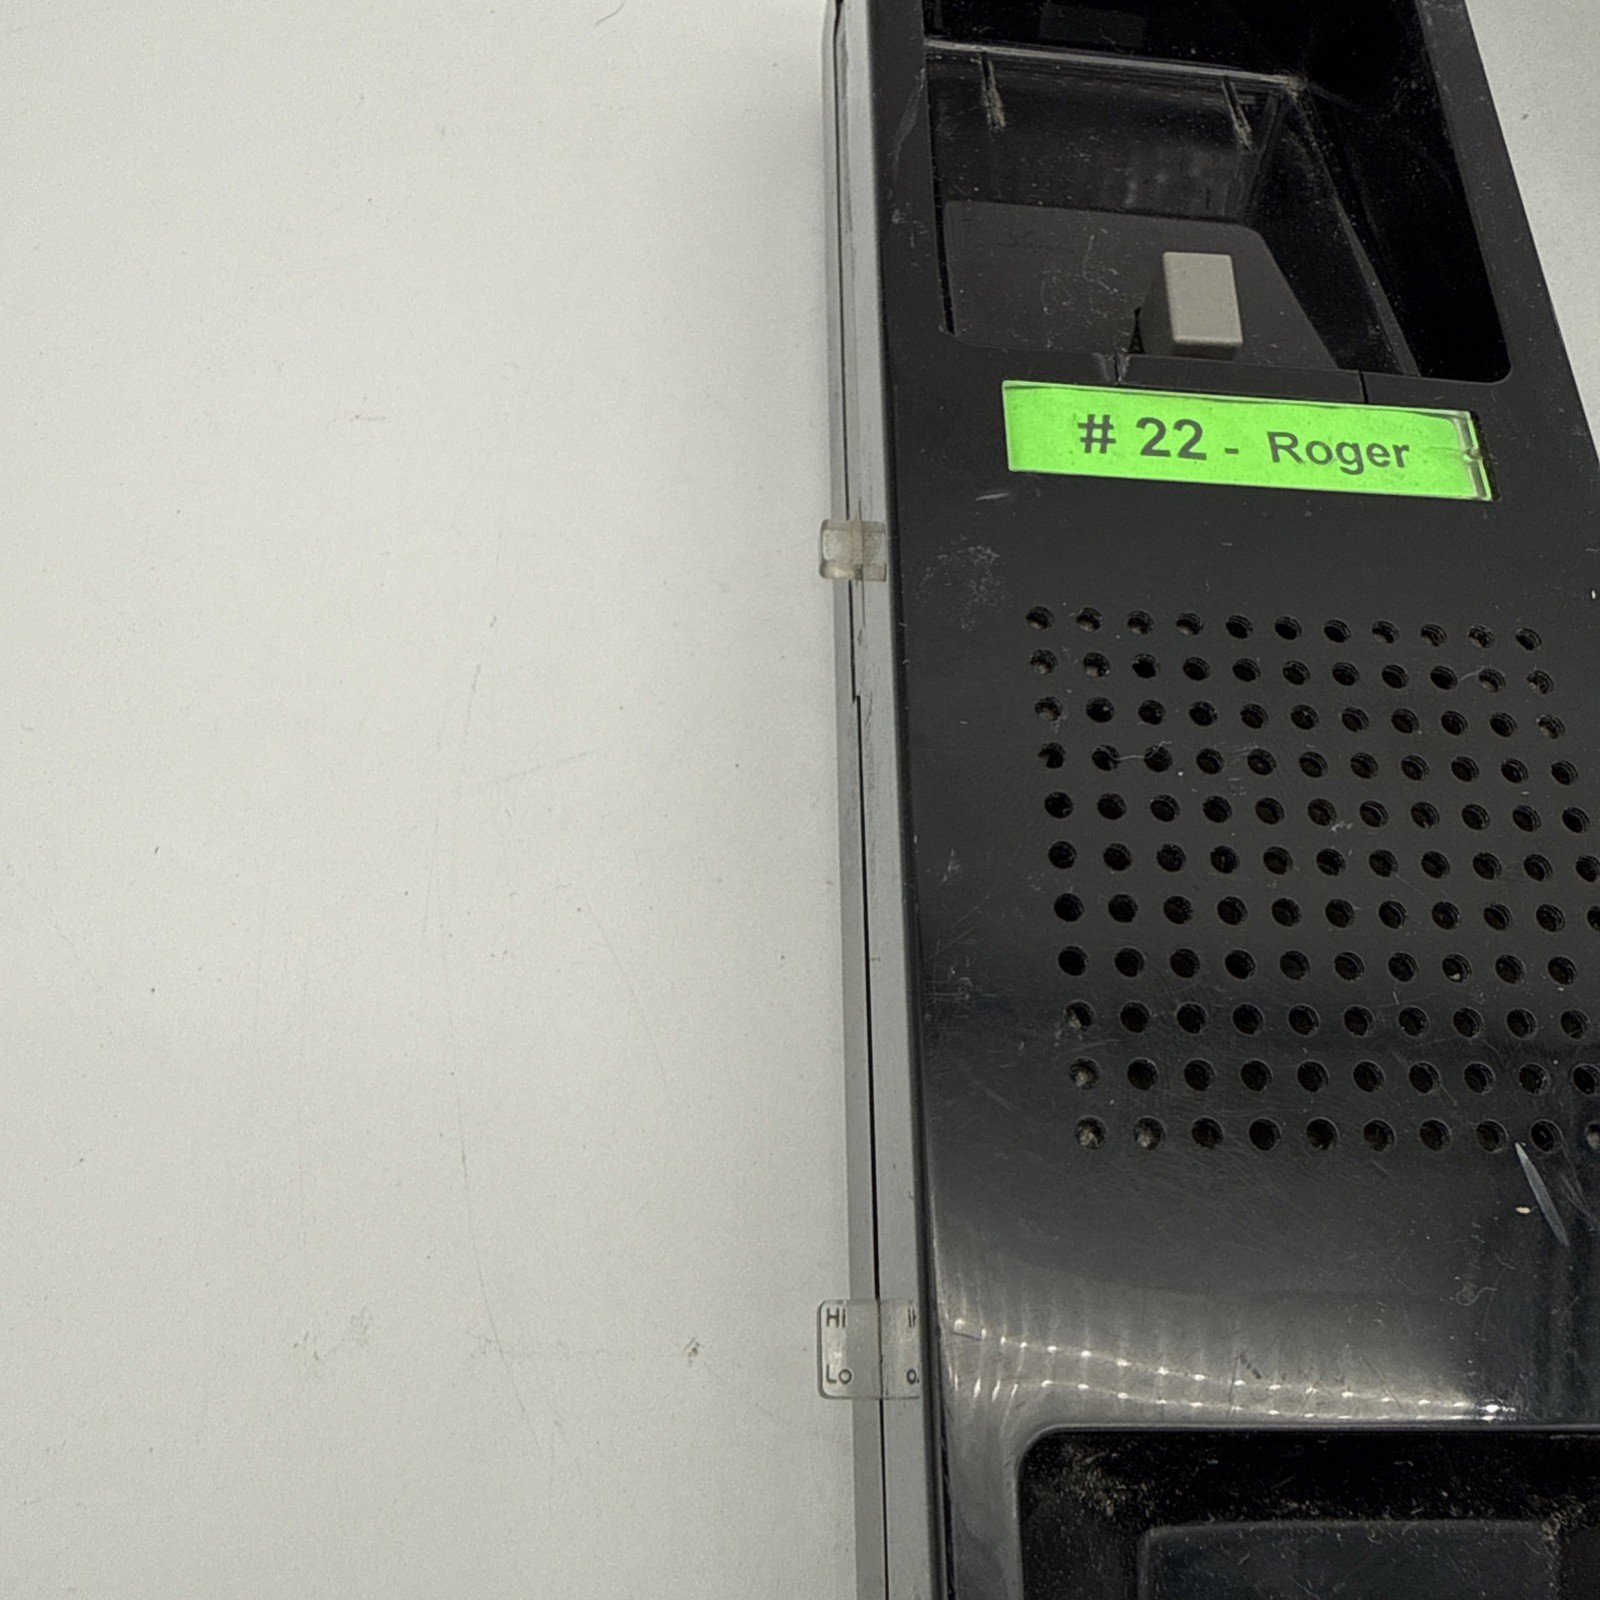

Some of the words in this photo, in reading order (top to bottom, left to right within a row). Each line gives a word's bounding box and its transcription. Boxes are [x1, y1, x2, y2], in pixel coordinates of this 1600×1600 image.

[1077, 413, 1117, 454] #
[1136, 416, 1208, 461] 22
[1225, 447, 1240, 455] -
[1267, 430, 1411, 476] Roger
